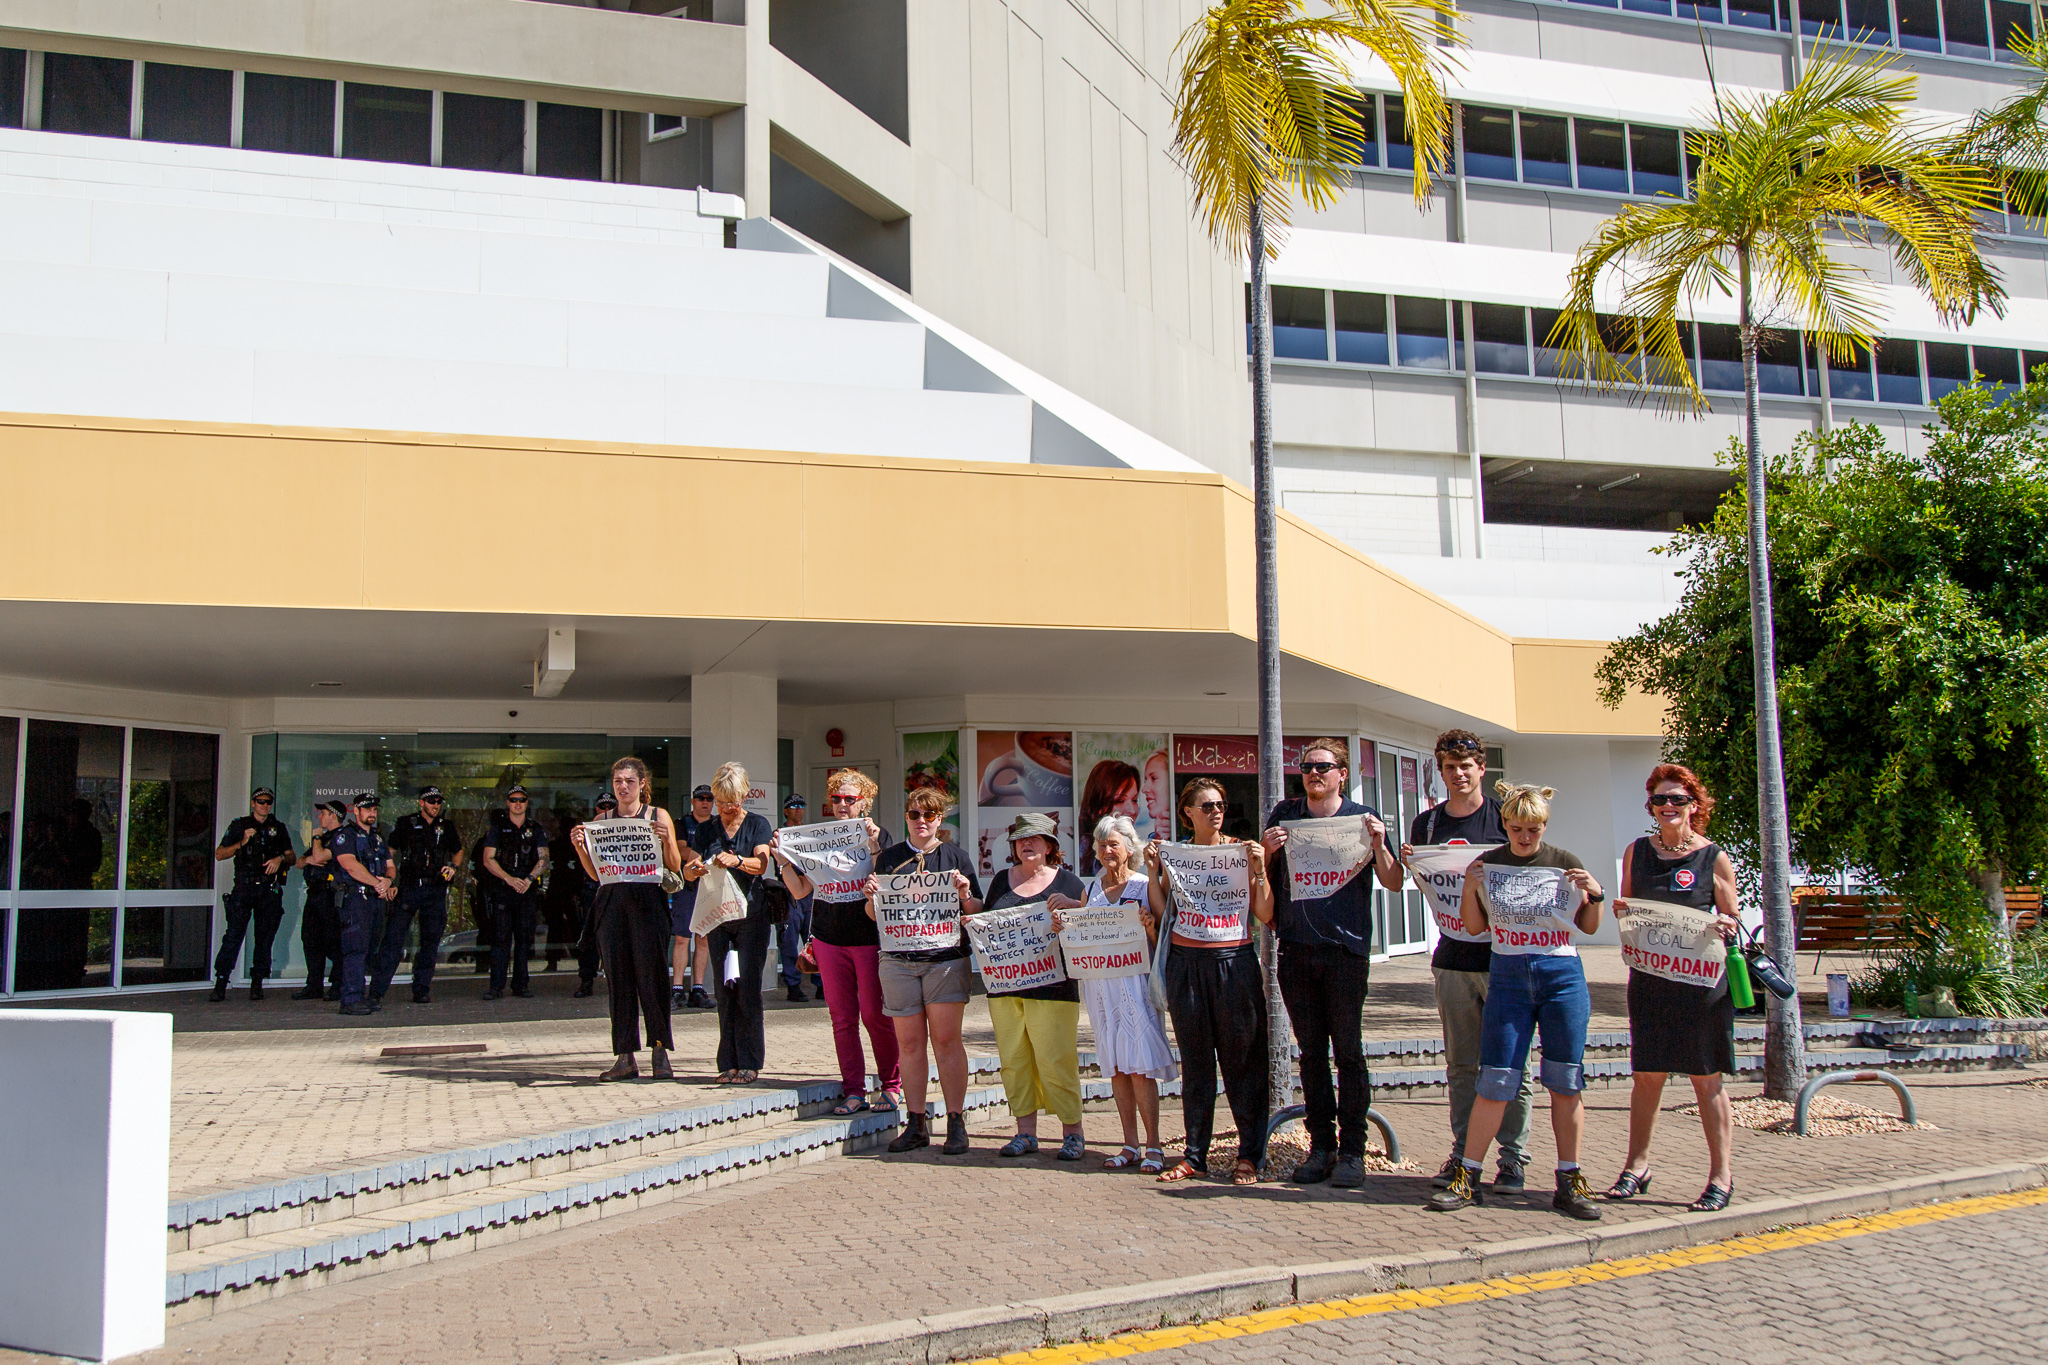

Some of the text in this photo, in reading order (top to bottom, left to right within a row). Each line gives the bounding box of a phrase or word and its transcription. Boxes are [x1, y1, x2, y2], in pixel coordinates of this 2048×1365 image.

[1080, 737, 1163, 759] Conversation
[1024, 766, 1072, 795] Coffee
[316, 788, 375, 796] NOW LEASING
[591, 825, 653, 835] GREW UP IN THE
[782, 823, 862, 842] OUR TAX FOR A
[1291, 828, 1315, 845] My
[594, 834, 652, 844] WHITSUNDAYS
[594, 843, 654, 853] I WON'T STOP
[846, 847, 867, 865] NO
[1289, 850, 1310, 860] Our
[621, 853, 640, 863] YOU
[642, 853, 657, 861] DO
[1302, 859, 1322, 870] Join
[599, 864, 657, 877] #STOPADANI
[1489, 871, 1539, 886] ADANI
[890, 872, 950, 891] C'MON
[1205, 874, 1228, 887] ARE
[881, 894, 910, 905] LET'S
[1489, 881, 1569, 901] ALL YOUR
[881, 908, 905, 921] THE
[1491, 904, 1552, 917] BELONG
[1492, 913, 1510, 925] TO
[1625, 907, 1654, 916] Water
[1682, 915, 1711, 928] more
[885, 921, 953, 938] #STOPADANI
[971, 912, 1045, 935] WE LOVE THE
[1626, 919, 1706, 938] important than
[978, 932, 1056, 955] WE'LL BE BACK TO
[1066, 934, 1076, 942] to
[1123, 930, 1138, 938] with
[1494, 925, 1570, 947] #STOPADANI
[1647, 929, 1694, 950] COAL
[989, 945, 1047, 963] PROTECT IT
[1071, 951, 1142, 969] #STOPADANI
[1624, 944, 1720, 979] #STOPADANI
[983, 955, 1056, 980] #STOPADANI
[1671, 972, 1708, 984] Townsville
